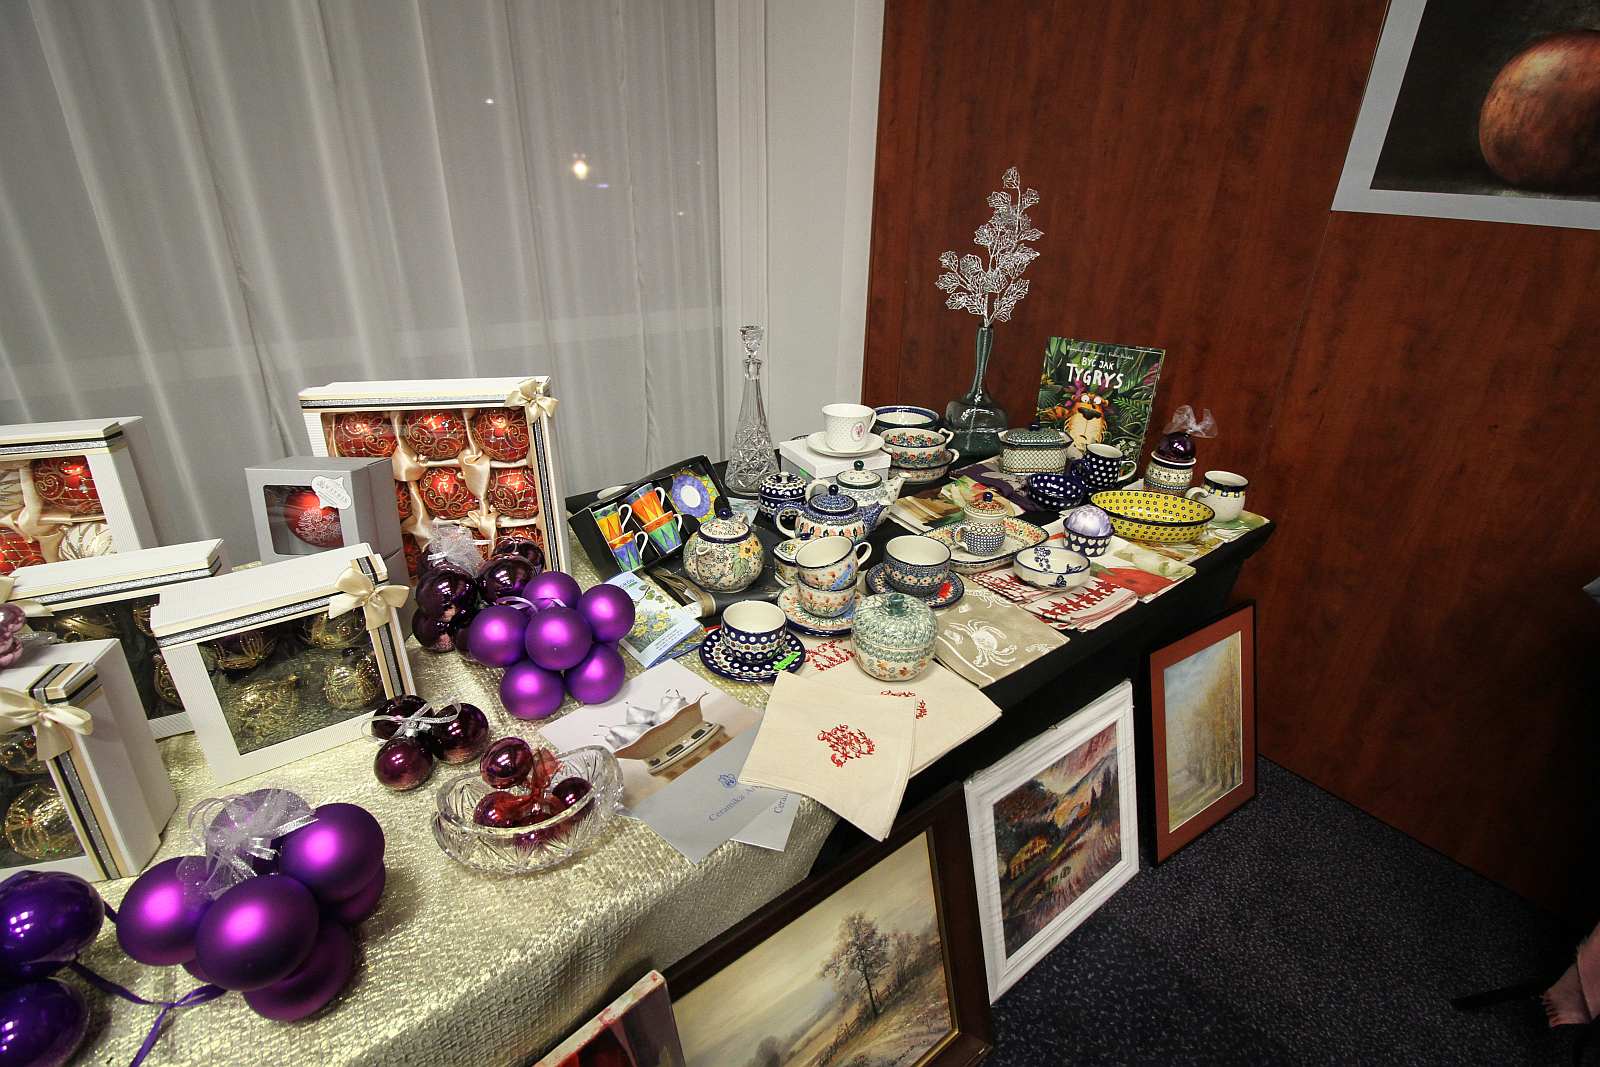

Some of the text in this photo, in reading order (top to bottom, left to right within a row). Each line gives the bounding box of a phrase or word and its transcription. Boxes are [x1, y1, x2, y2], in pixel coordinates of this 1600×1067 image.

[1081, 355, 1097, 367] BYĆ
[1098, 361, 1114, 370] JAK
[1066, 363, 1124, 389] TYGRYS
